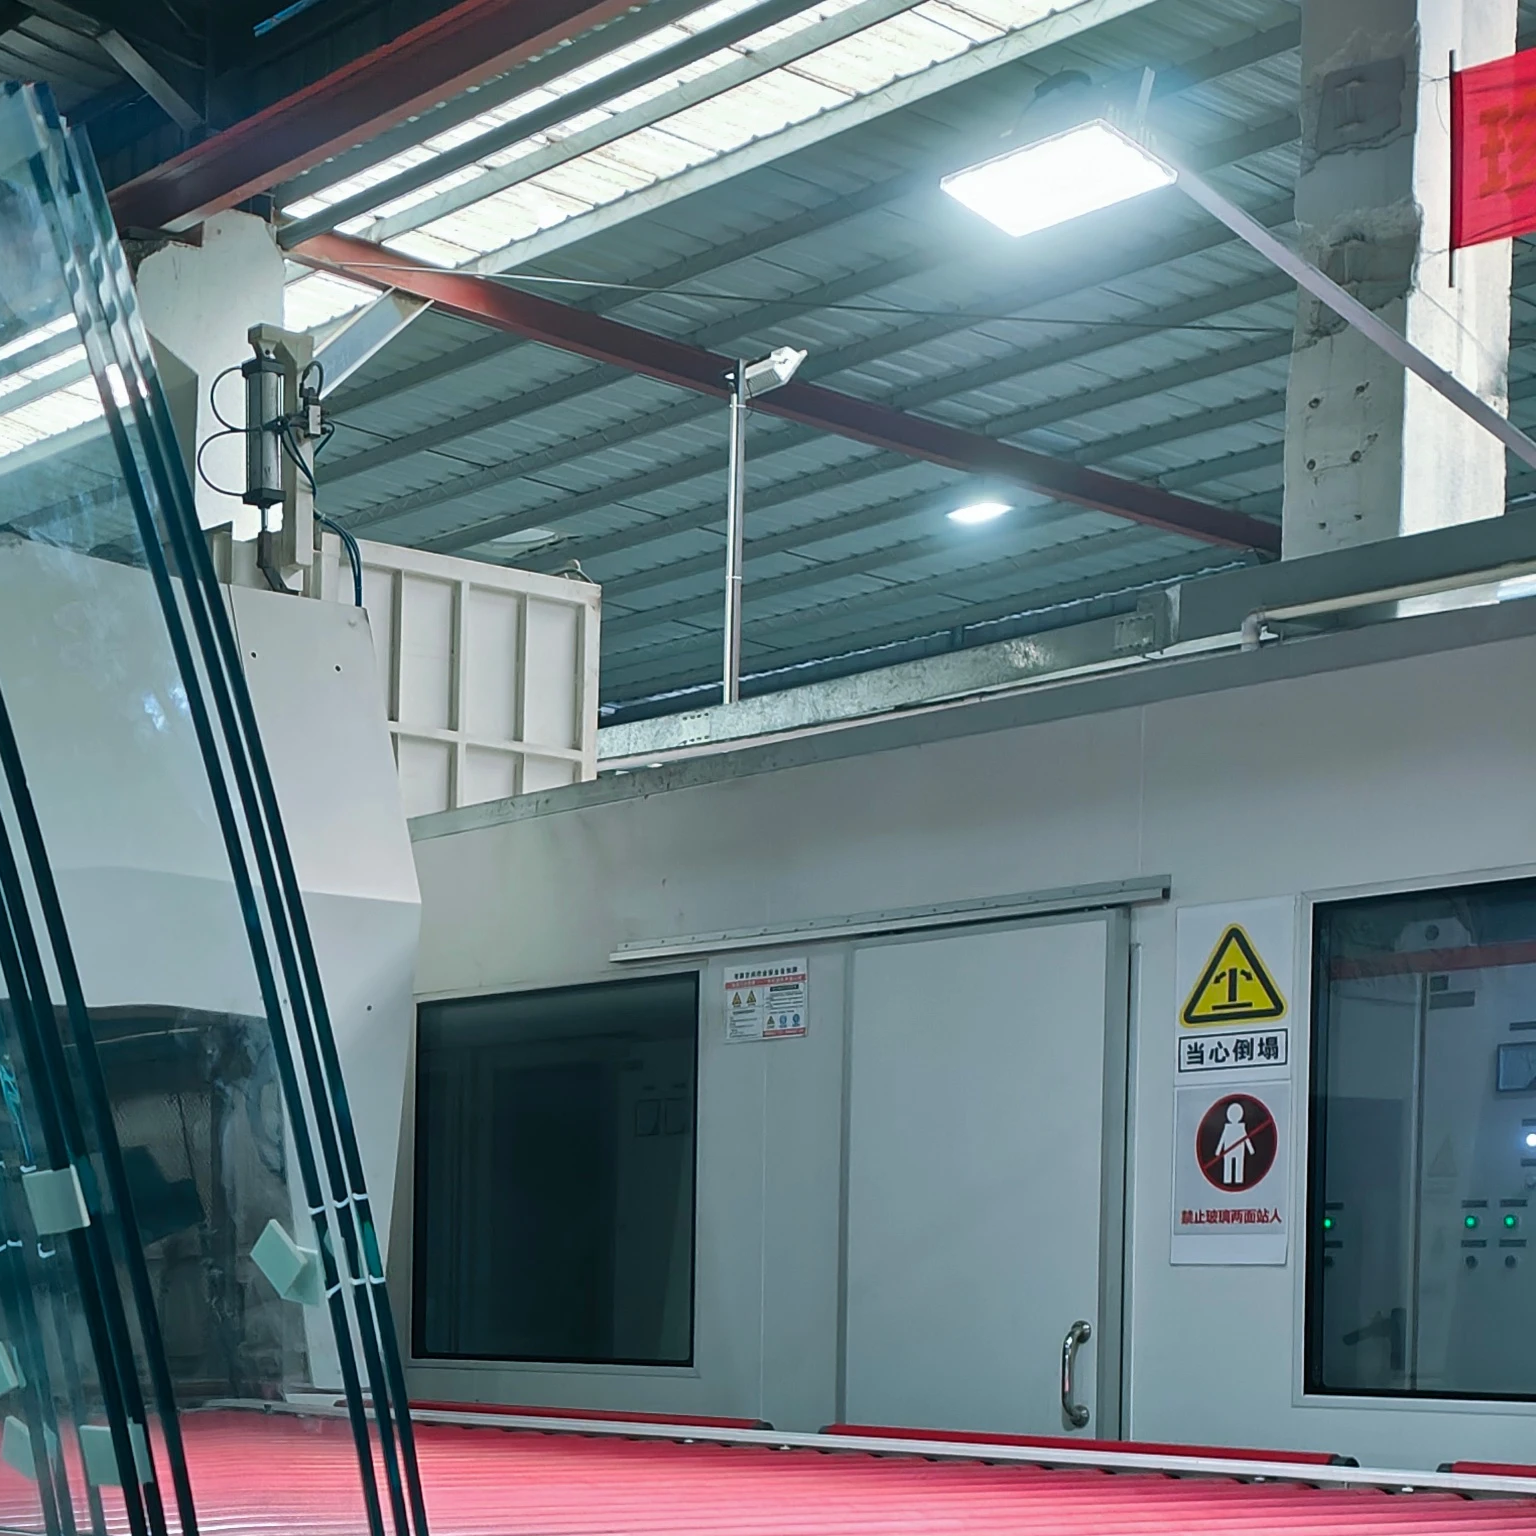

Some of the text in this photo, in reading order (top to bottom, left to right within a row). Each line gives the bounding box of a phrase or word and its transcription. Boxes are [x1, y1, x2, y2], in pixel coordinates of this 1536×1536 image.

[1186, 1036, 1279, 1065] 当心倒塌
[1181, 1208, 1282, 1225] 禁止玻璃两面站人
